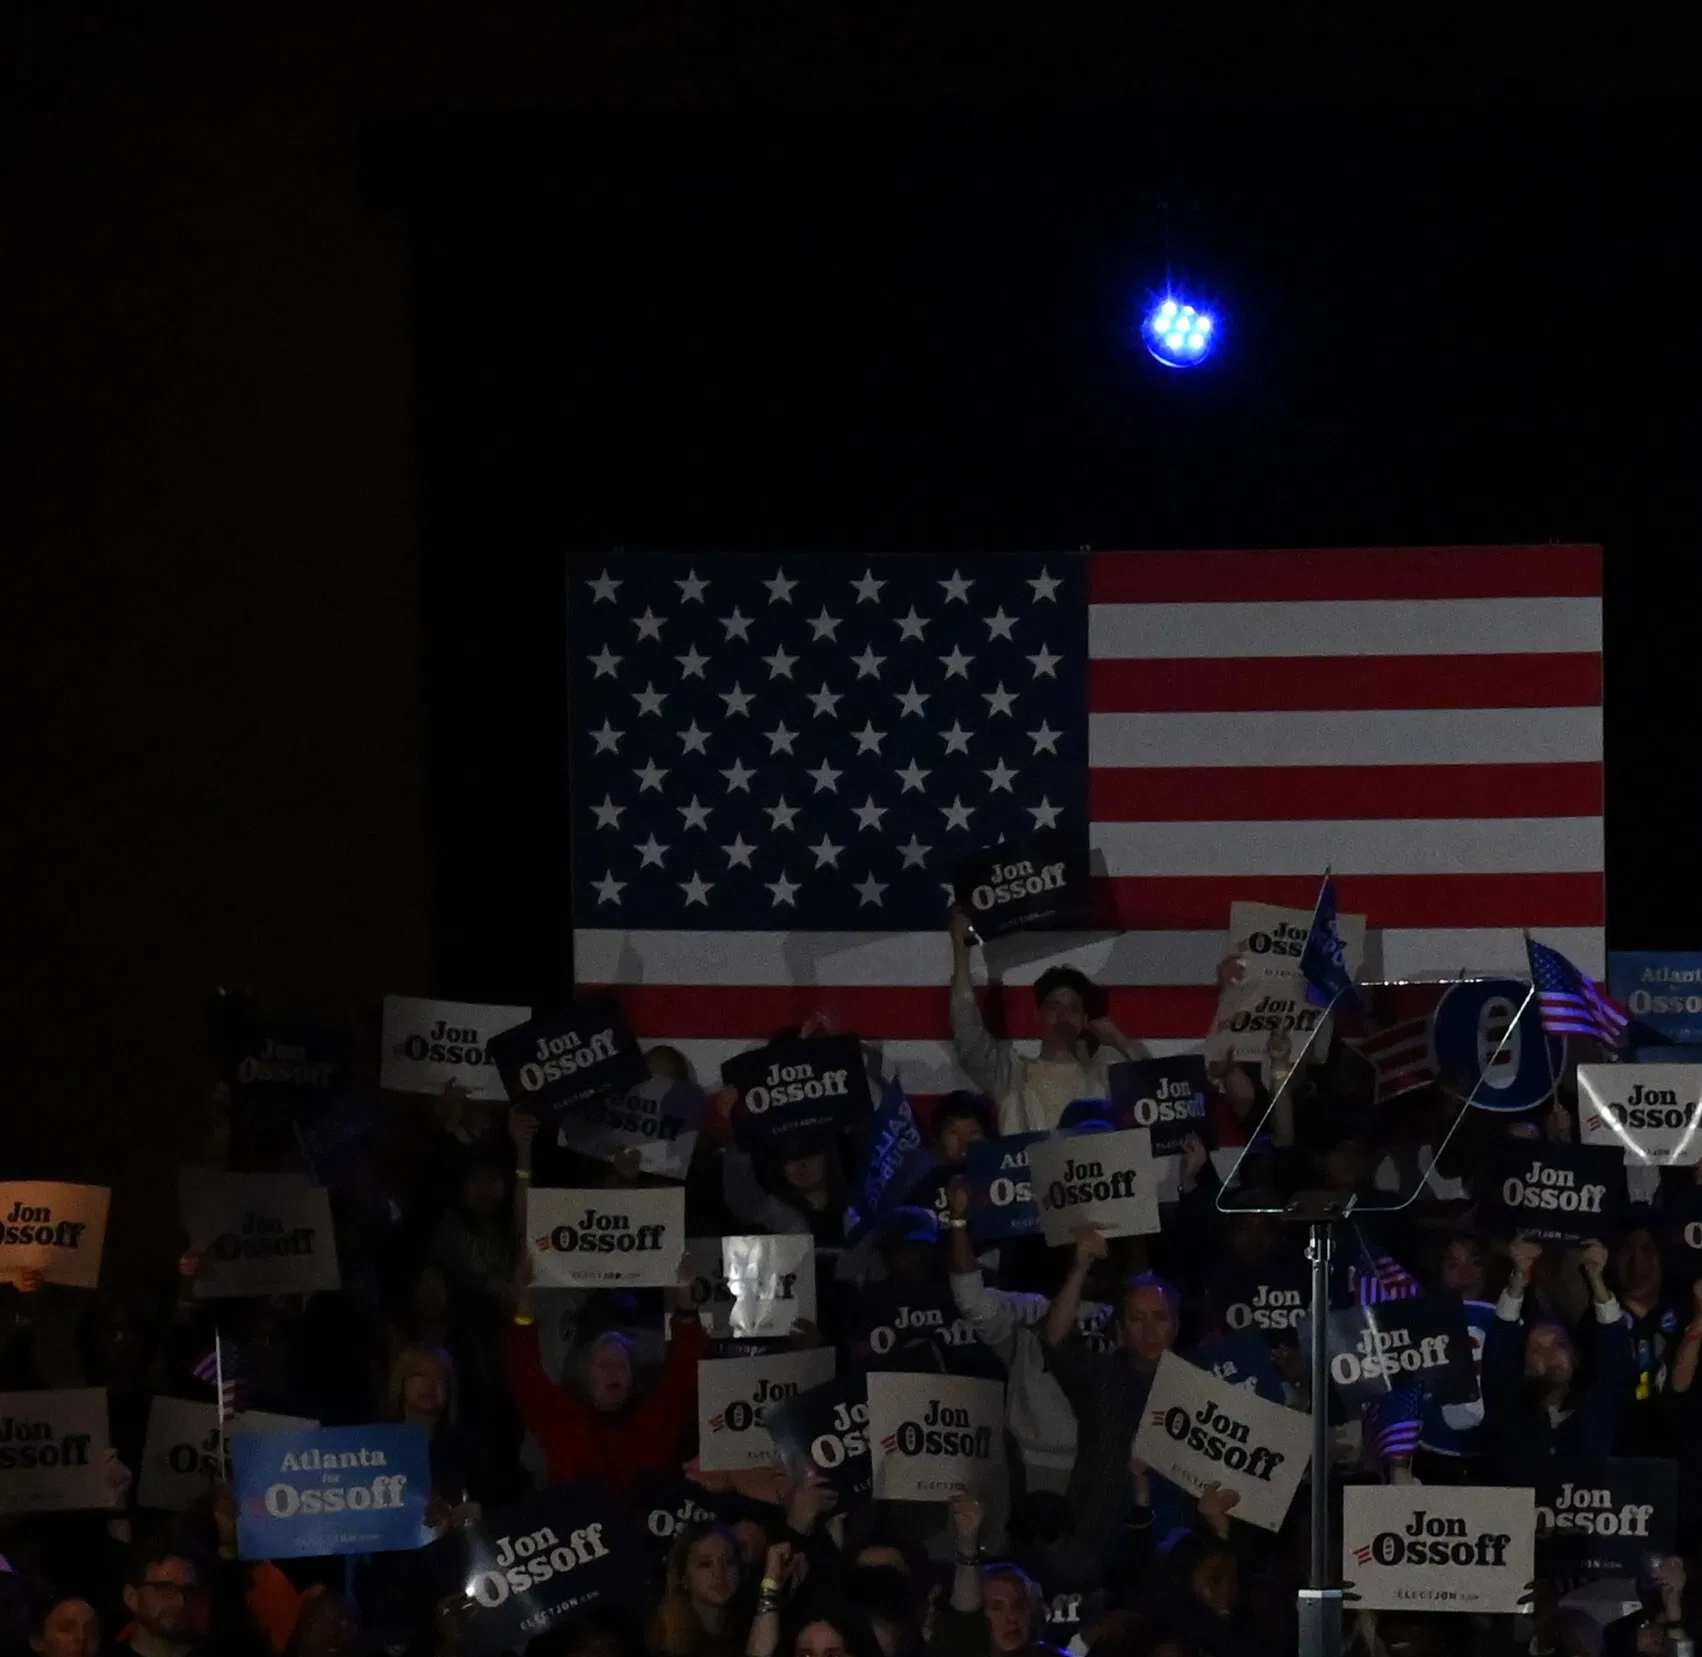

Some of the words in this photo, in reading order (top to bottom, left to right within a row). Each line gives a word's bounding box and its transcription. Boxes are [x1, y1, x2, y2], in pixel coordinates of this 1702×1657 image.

[990, 857, 1033, 884] Jon
[971, 861, 1068, 911] Ossoff
[429, 1020, 478, 1044] Jon
[536, 1028, 582, 1062] Jon
[518, 1027, 617, 1093] Ossoff
[765, 1060, 814, 1085] Jon
[745, 1068, 849, 1114] Ossoff
[1627, 1084, 1677, 1107] Jon
[1063, 1159, 1103, 1184] Jon
[1525, 1160, 1576, 1188] Jon
[1049, 1170, 1137, 1210] Ossoff
[1502, 1179, 1606, 1214] Ossoff
[7, 1201, 51, 1223] Jon
[578, 1209, 629, 1232] Jon
[551, 1225, 665, 1254] Ossoff
[1252, 1286, 1300, 1309] Jon
[893, 1305, 944, 1329] Jon
[924, 1400, 970, 1428] Jon
[1195, 1400, 1251, 1444] Jon
[896, 1422, 991, 1459] Ossoff
[1163, 1405, 1285, 1482] Ossoff
[279, 1446, 388, 1473] Atlanta
[263, 1473, 408, 1520] Ossoff
[1555, 1482, 1612, 1510] Jon
[1405, 1511, 1467, 1537] Jon
[495, 1521, 559, 1569] Jon
[1371, 1533, 1510, 1567] Ossoff
[469, 1519, 611, 1609] Ossoff
[1396, 1588, 1480, 1601] ELECTJON.COM
